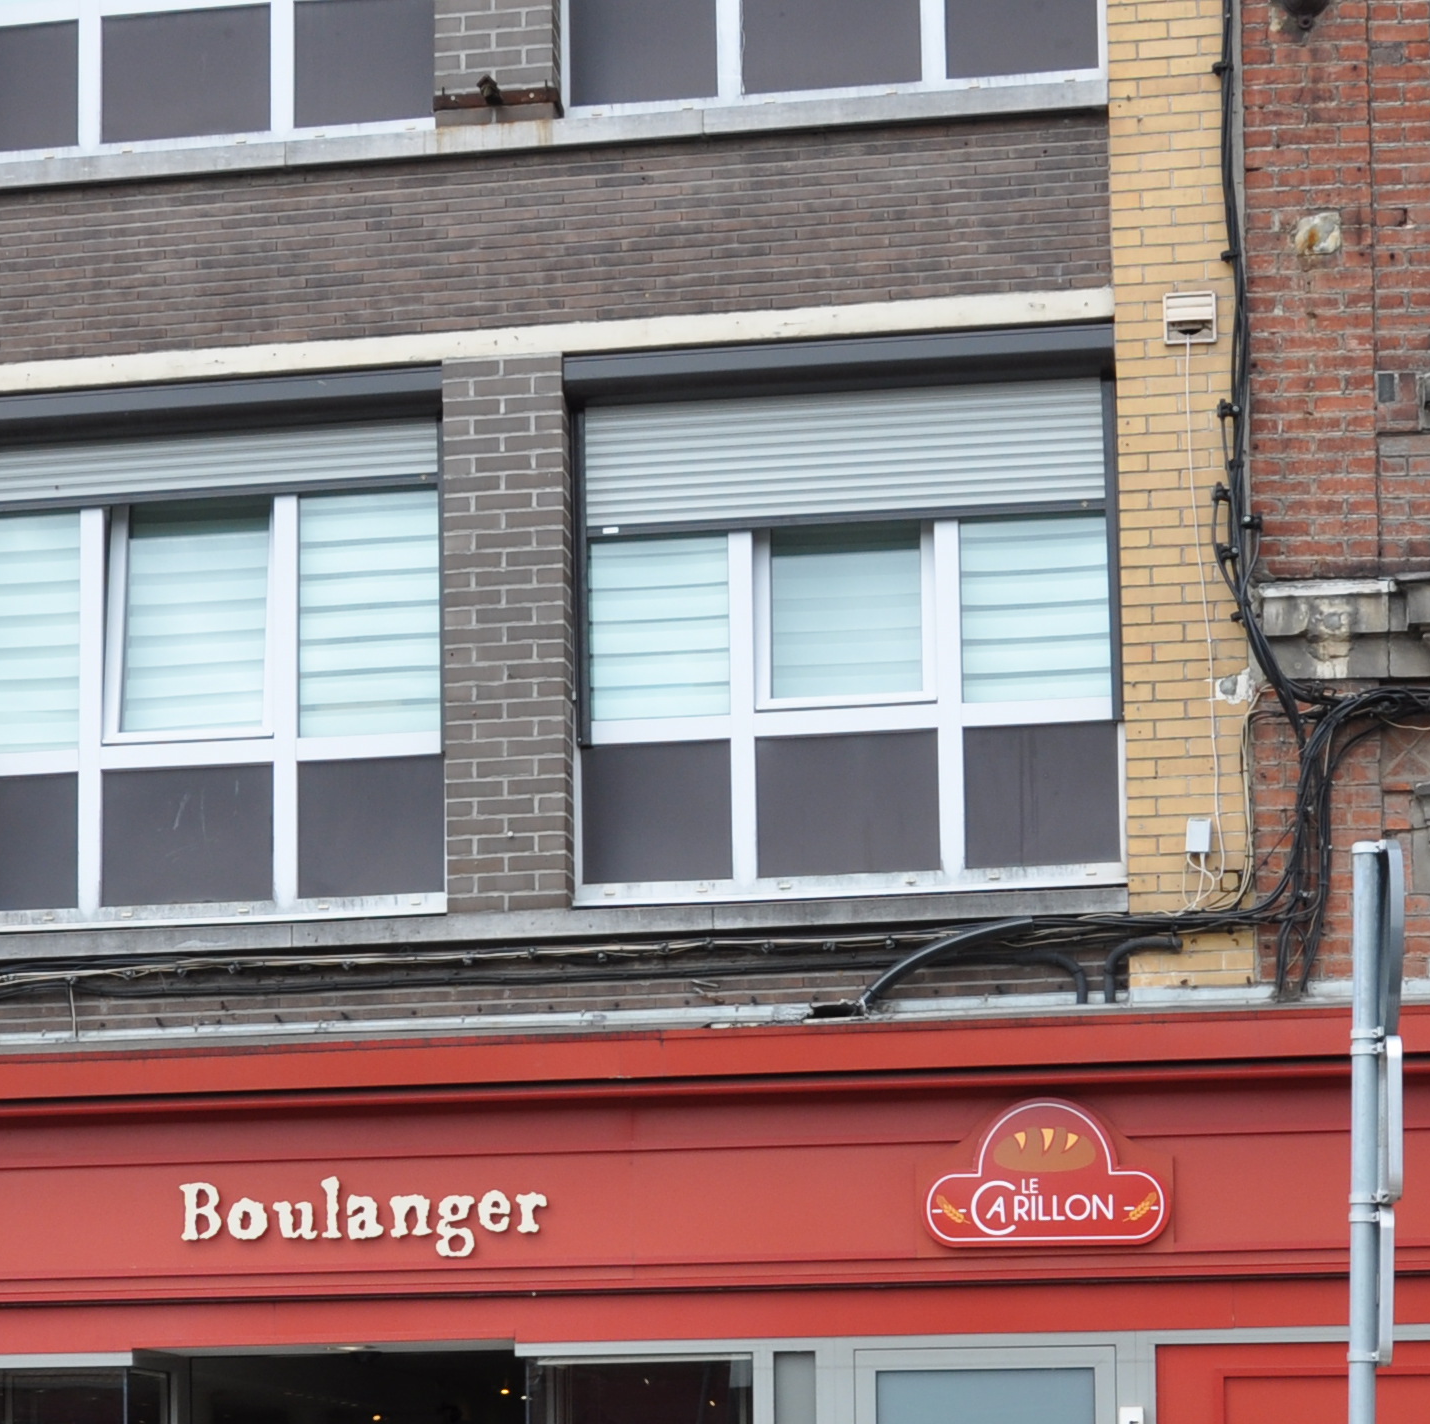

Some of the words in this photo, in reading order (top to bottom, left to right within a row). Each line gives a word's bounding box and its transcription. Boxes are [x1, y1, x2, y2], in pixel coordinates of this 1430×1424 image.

[971, 1180, 1114, 1236] CARILLON
[1021, 1178, 1039, 1195] LE
[179, 1176, 548, 1258] Boulanger
